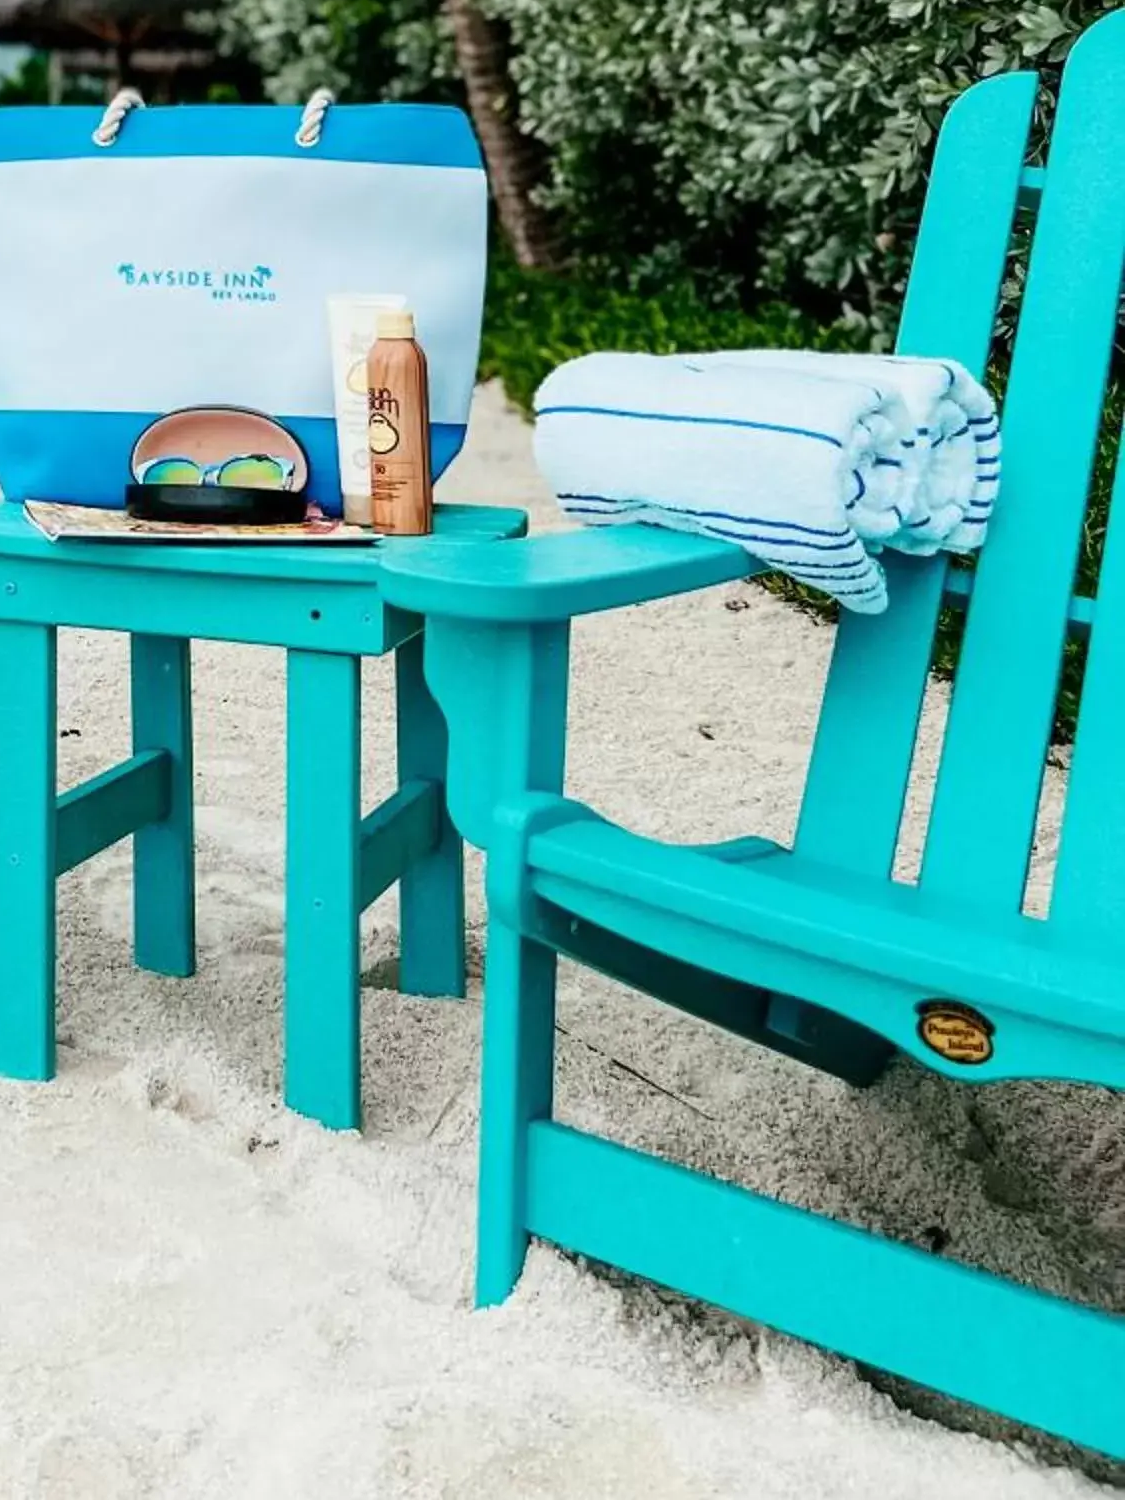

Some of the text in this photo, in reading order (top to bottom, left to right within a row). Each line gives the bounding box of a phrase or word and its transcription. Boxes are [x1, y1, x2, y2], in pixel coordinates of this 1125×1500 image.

[124, 269, 265, 288] BAYSIDE INN
[237, 291, 277, 302] LARGO
